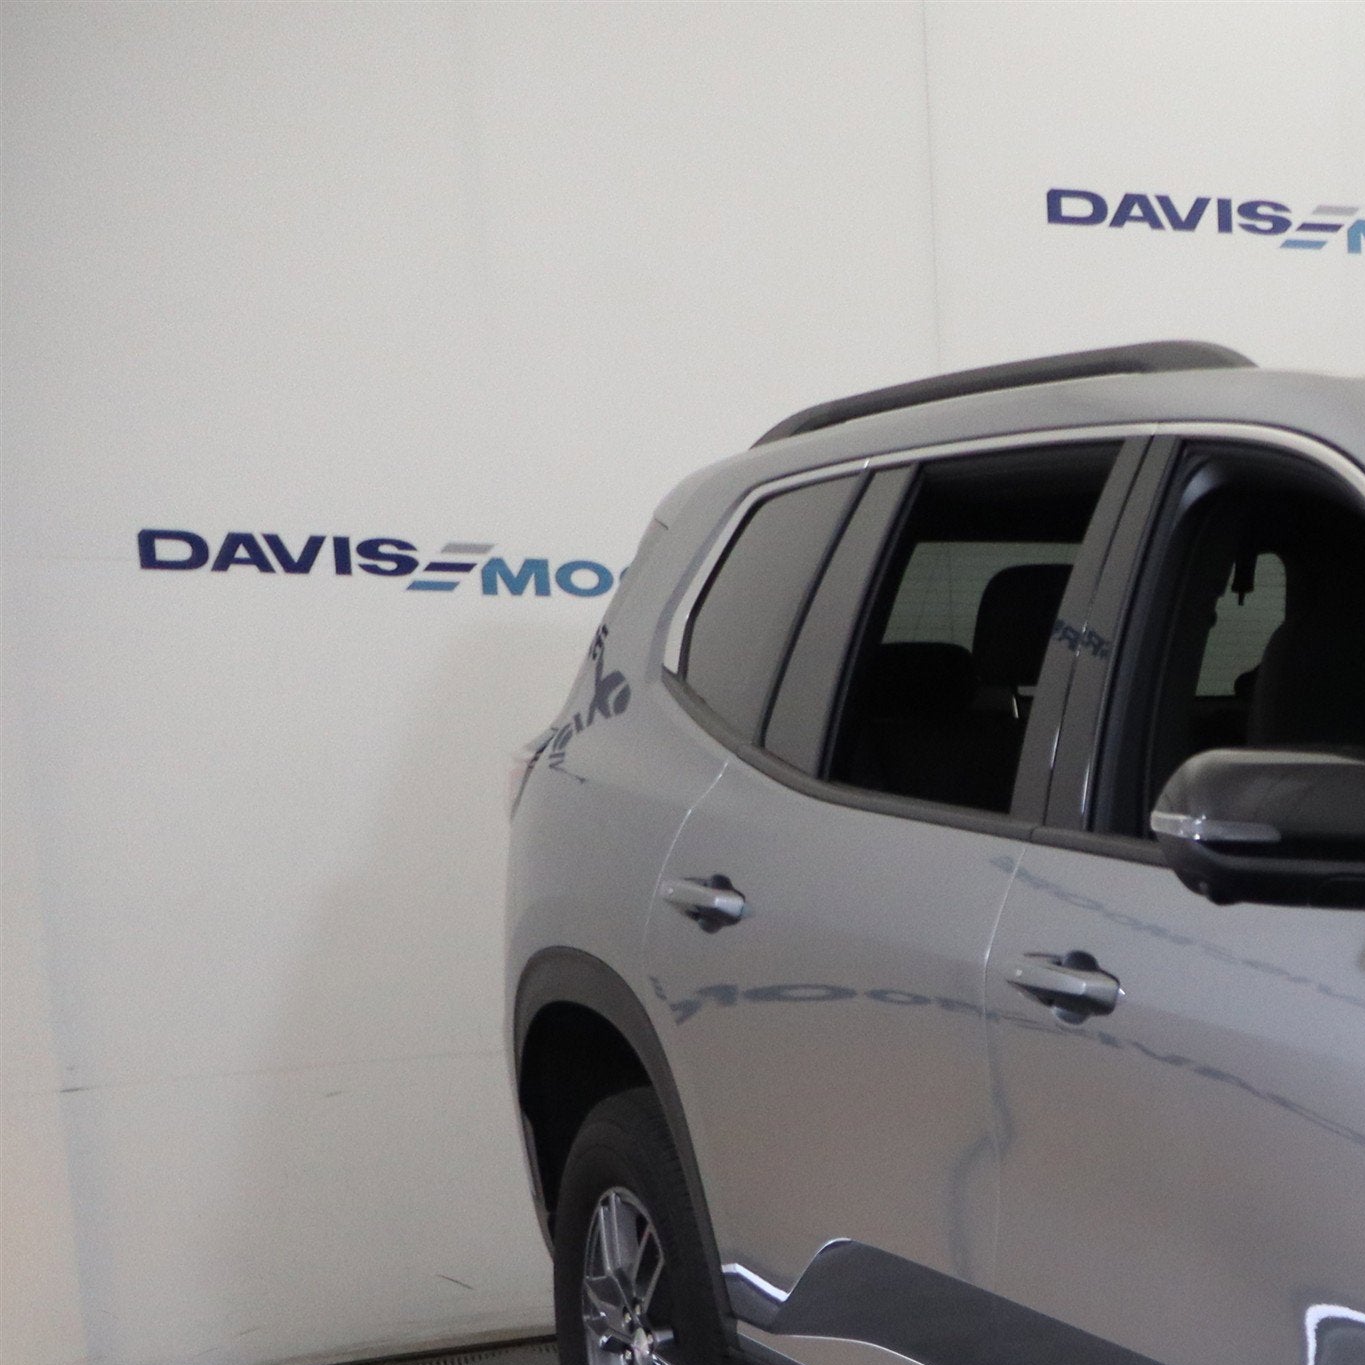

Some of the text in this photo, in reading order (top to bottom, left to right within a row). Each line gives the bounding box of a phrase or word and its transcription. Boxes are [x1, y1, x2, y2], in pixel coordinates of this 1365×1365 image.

[1045, 186, 1294, 237] DAVIS
[136, 526, 634, 599] DAVIS MO
